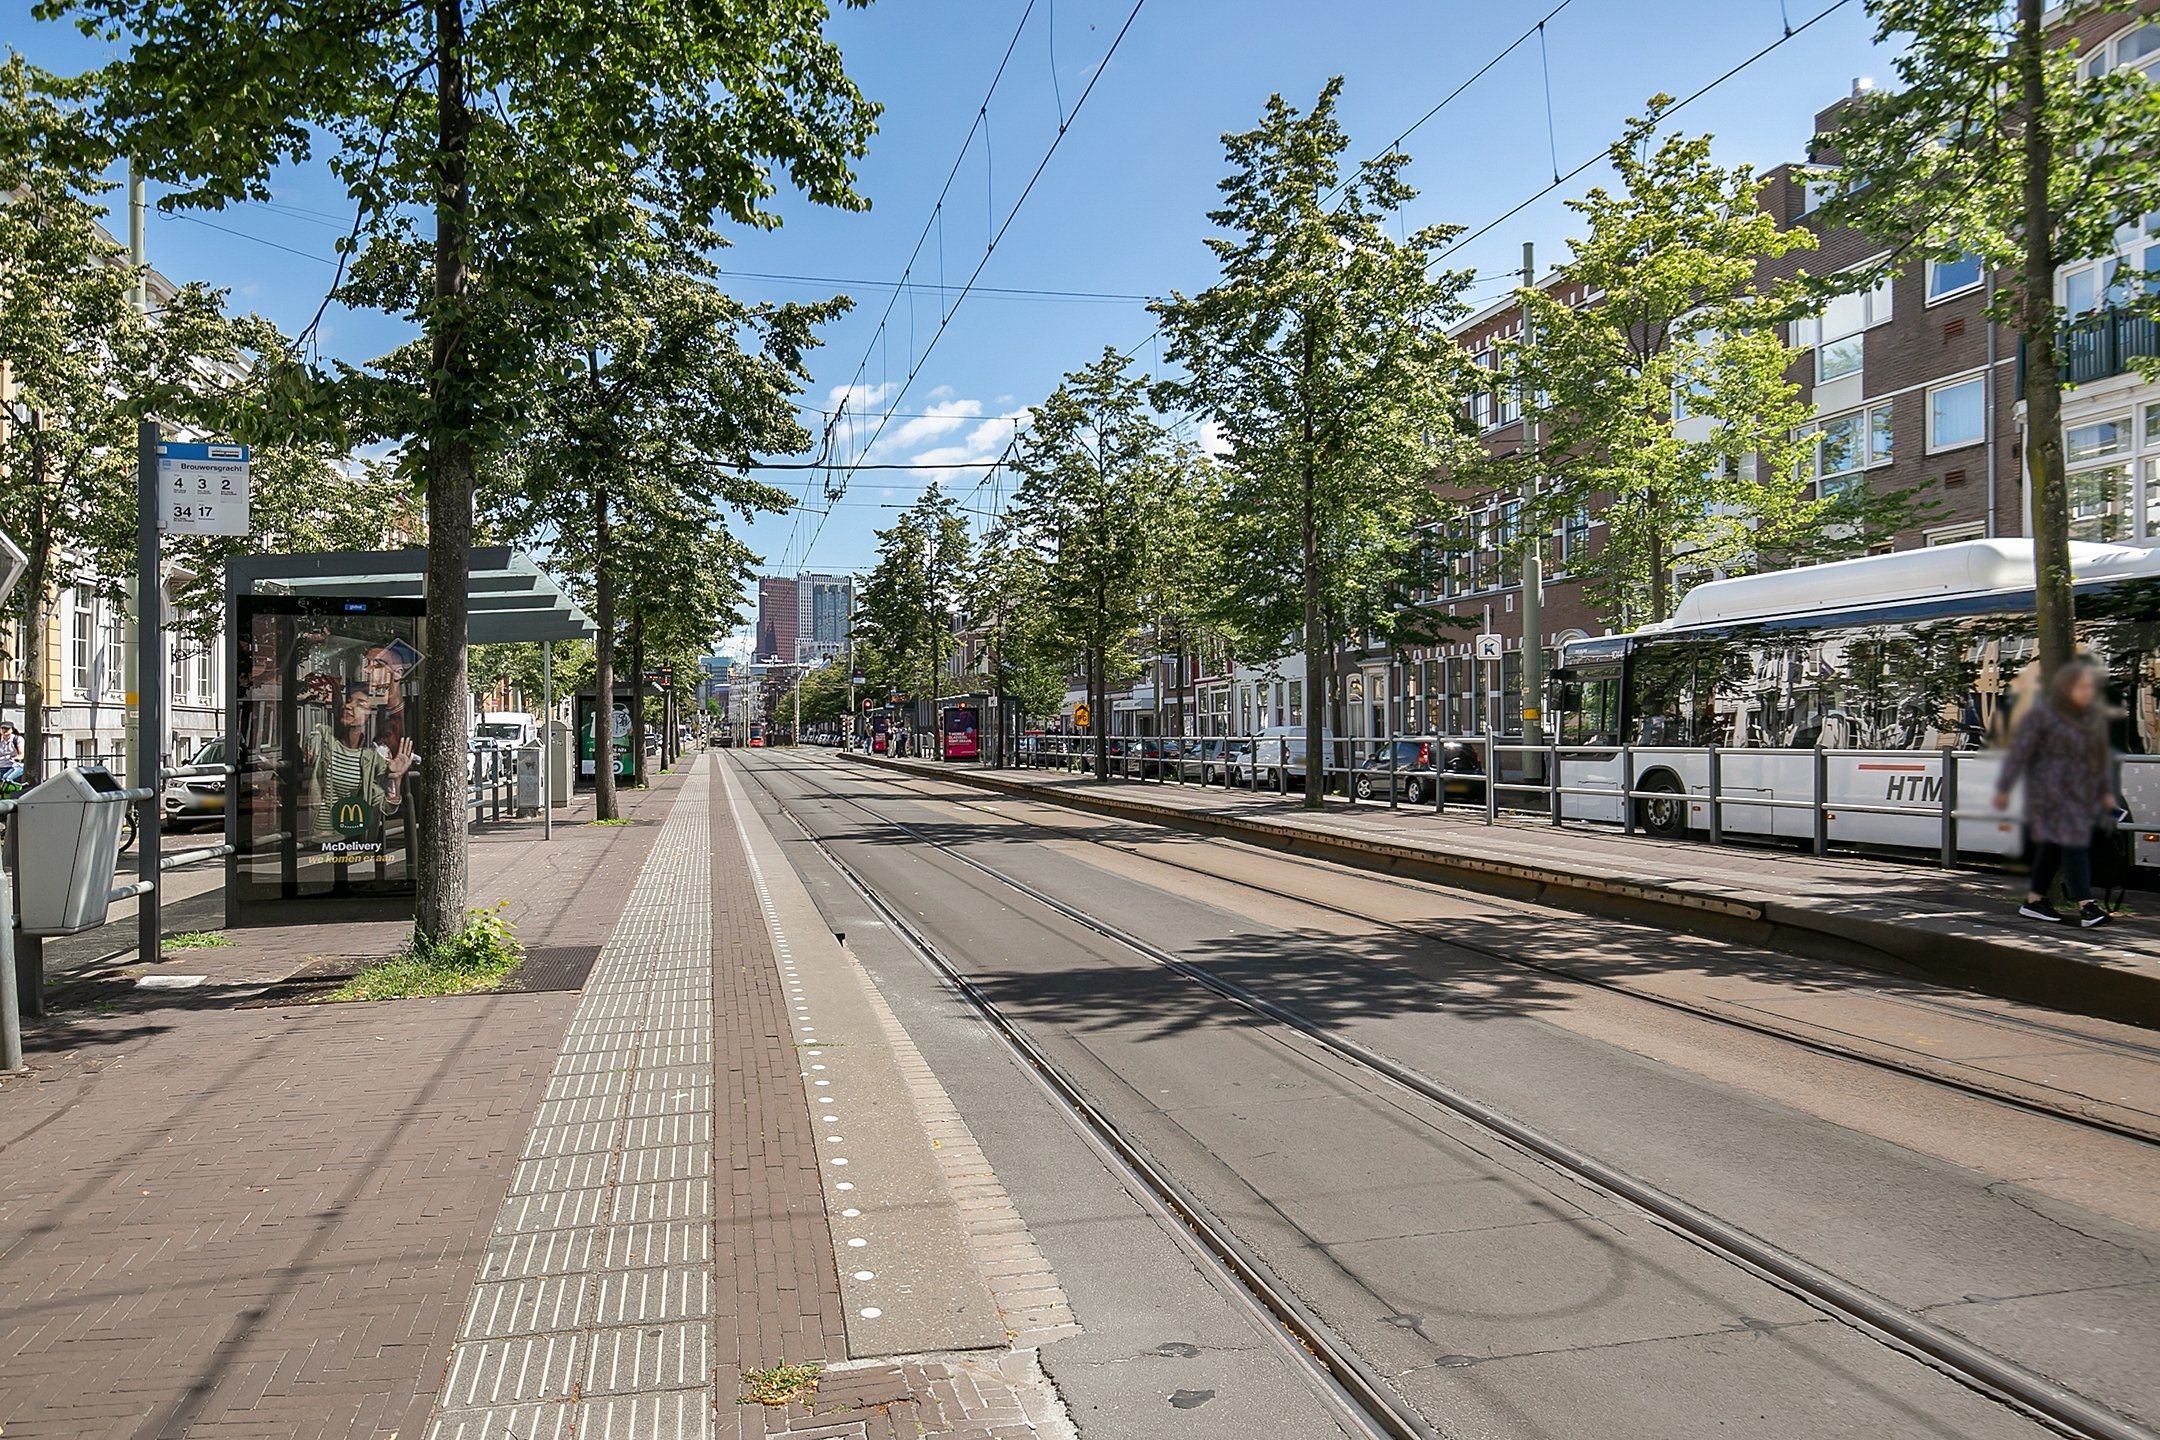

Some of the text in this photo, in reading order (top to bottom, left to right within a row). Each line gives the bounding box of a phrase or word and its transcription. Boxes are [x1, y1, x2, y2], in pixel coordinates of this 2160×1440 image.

[180, 463, 242, 472] Brouwersgracht
[174, 478, 231, 490] 4 3 2
[173, 506, 213, 517] 34 17
[1484, 643, 1495, 655] K
[1886, 776, 1943, 802] HTM
[321, 841, 382, 852] McDelivery
[308, 854, 395, 864] we komen er aan
